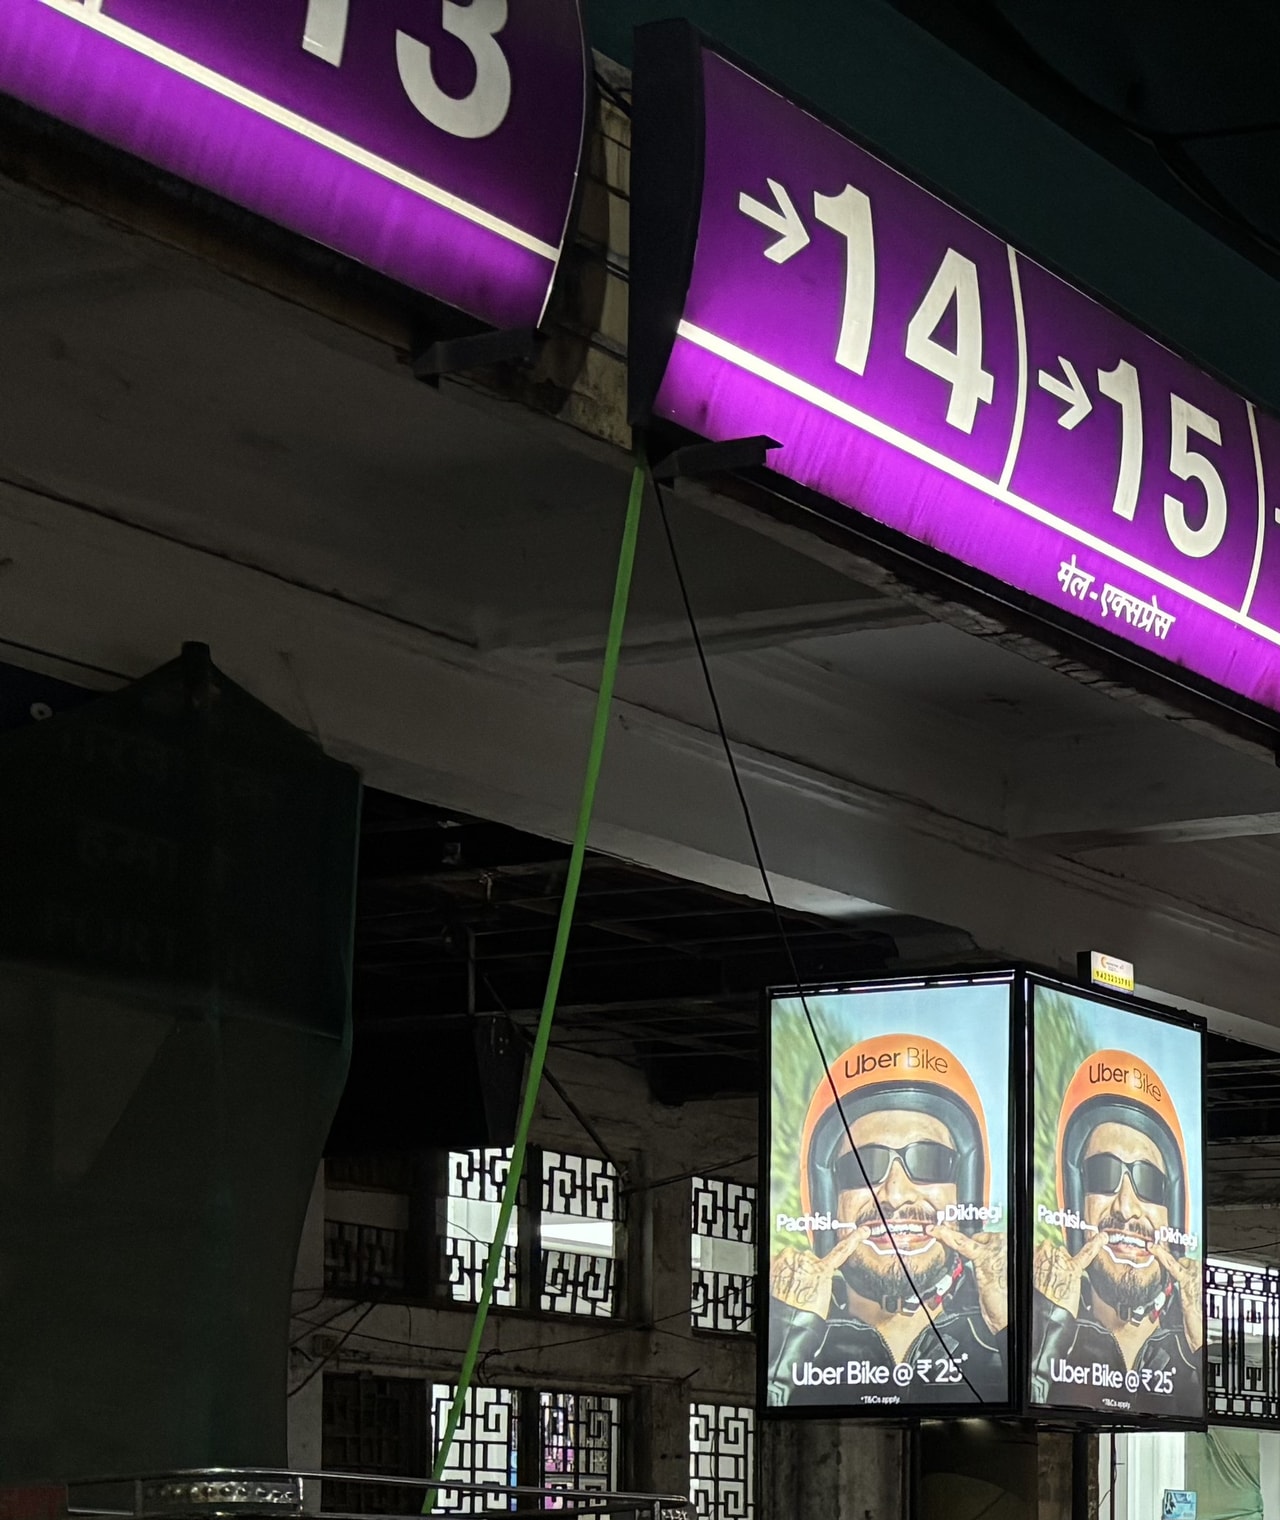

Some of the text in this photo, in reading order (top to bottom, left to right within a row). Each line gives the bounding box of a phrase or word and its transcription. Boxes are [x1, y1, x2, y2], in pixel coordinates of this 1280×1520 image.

[301, 0, 512, 140] 3
[813, 183, 995, 435] 14
[1097, 358, 1228, 558] 15
[844, 1046, 949, 1079] Uber Bike
[1089, 1062, 1162, 1102] Uber Bike
[776, 1213, 832, 1232] Pachisi
[791, 1361, 845, 1386] Uber
[846, 1360, 890, 1385] Bike
[892, 1362, 914, 1387] @
[1050, 1357, 1090, 1385] Uber
[1091, 1362, 1123, 1389] Bike
[1124, 1369, 1140, 1393] @
